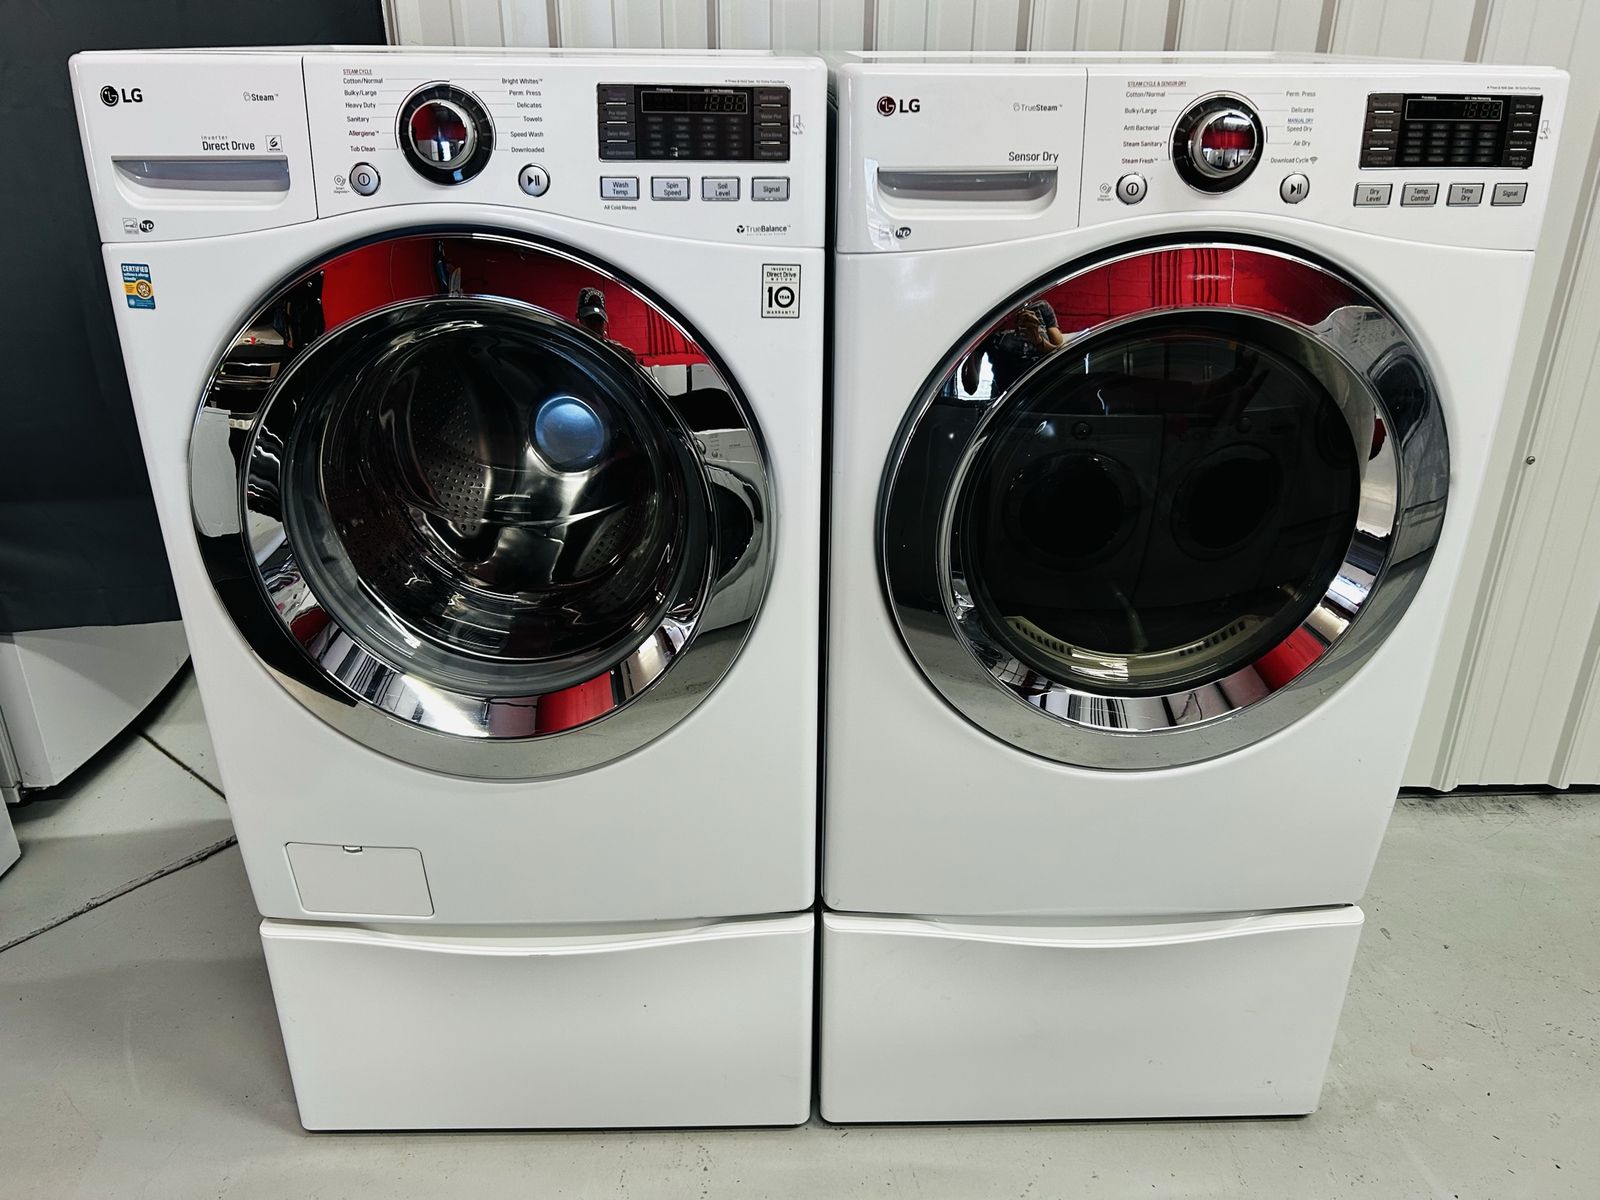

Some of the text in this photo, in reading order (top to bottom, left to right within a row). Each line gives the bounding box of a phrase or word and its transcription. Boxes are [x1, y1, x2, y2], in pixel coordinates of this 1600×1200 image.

[121, 88, 143, 103] LG
[899, 99, 920, 113] LG
[202, 141, 255, 151] Direct Drive
[1008, 151, 1059, 163] Sensor Dry
[122, 265, 148, 273] CERTIFIED
[767, 286, 795, 308] 10
